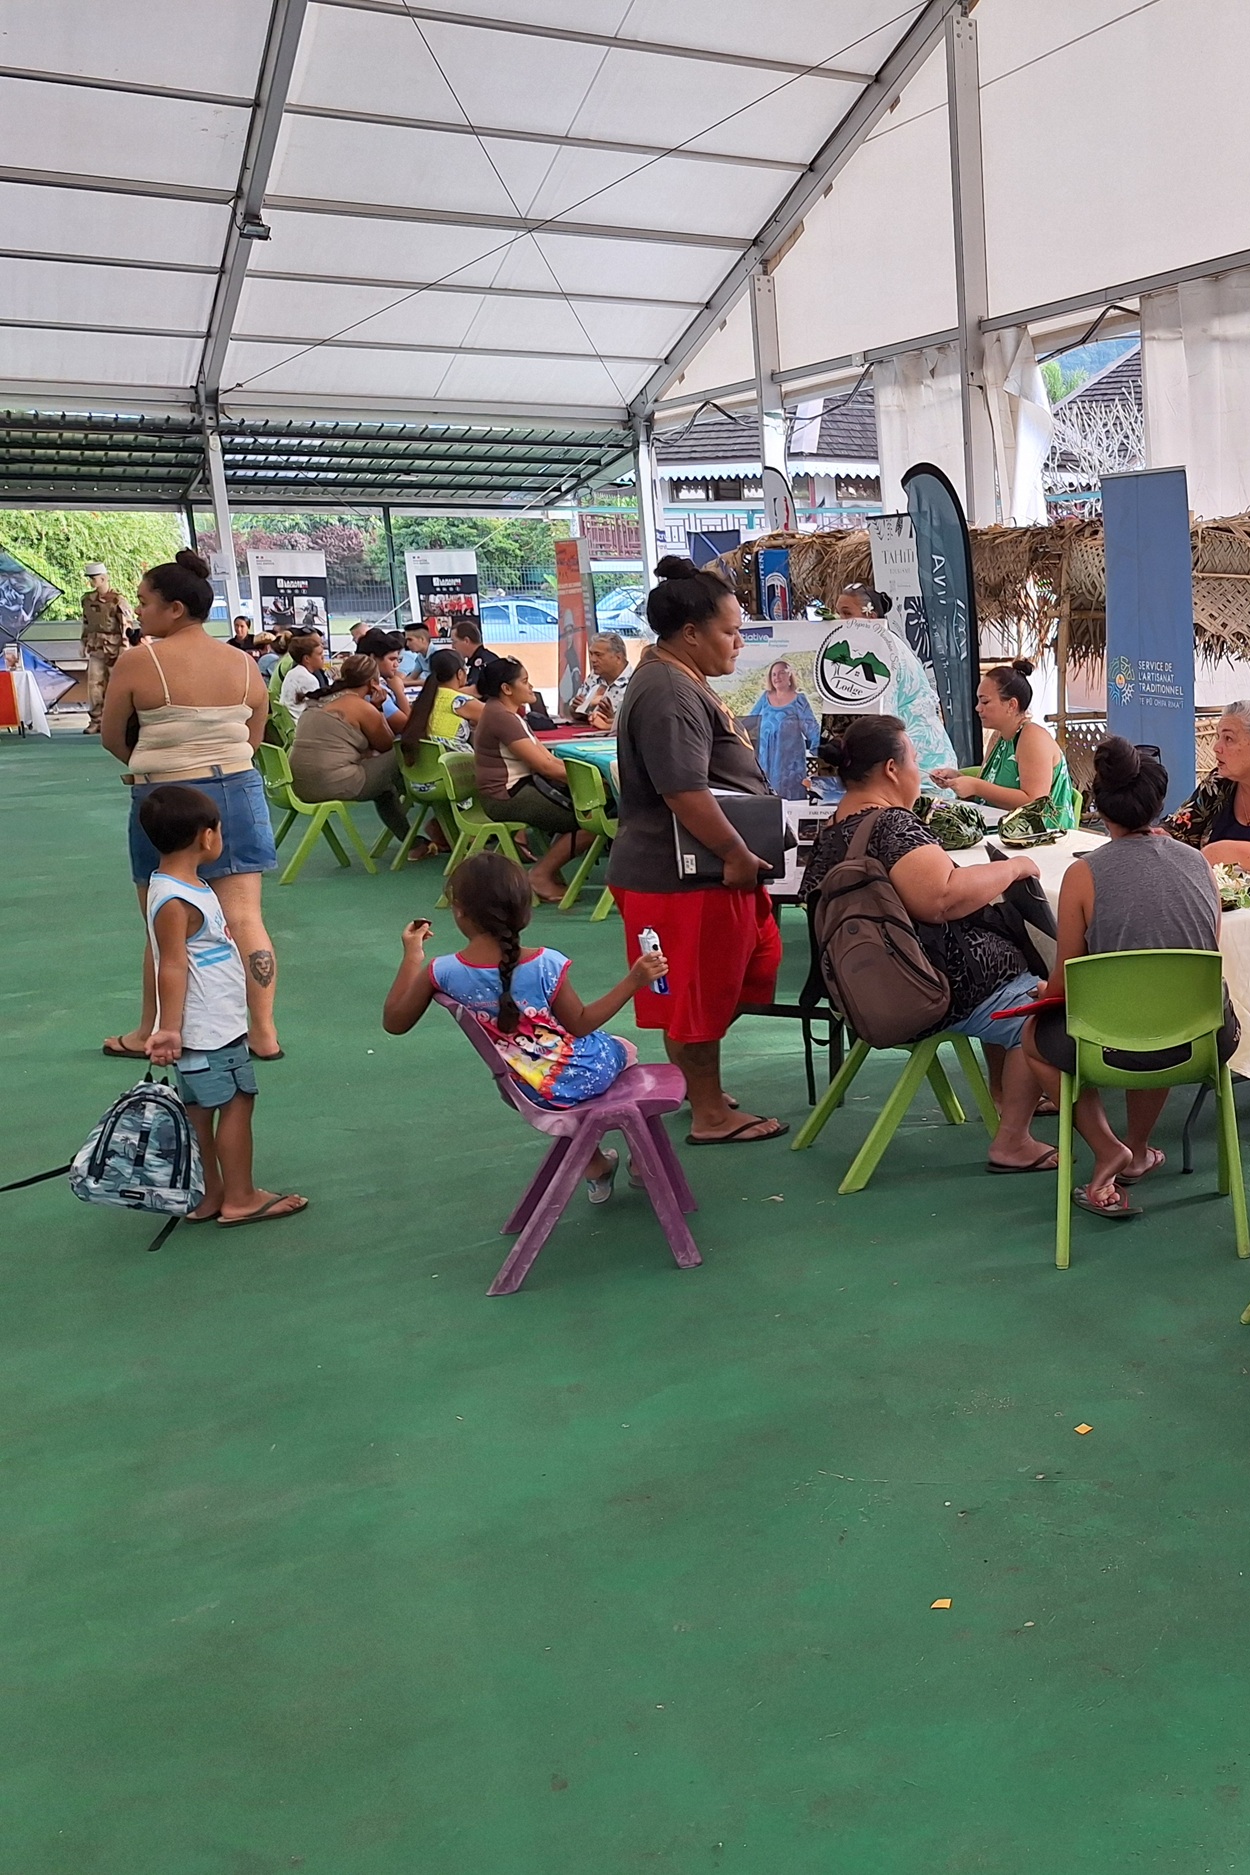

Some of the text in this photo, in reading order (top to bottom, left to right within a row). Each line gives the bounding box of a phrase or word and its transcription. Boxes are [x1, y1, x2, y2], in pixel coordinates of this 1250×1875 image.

[741, 632, 769, 641] tiative
[1138, 660, 1173, 673] SERVICE DE
[1138, 672, 1175, 684] L'ARTISANAT
[833, 679, 865, 697] Lodge
[1138, 682, 1184, 696] TRADITIONNEL
